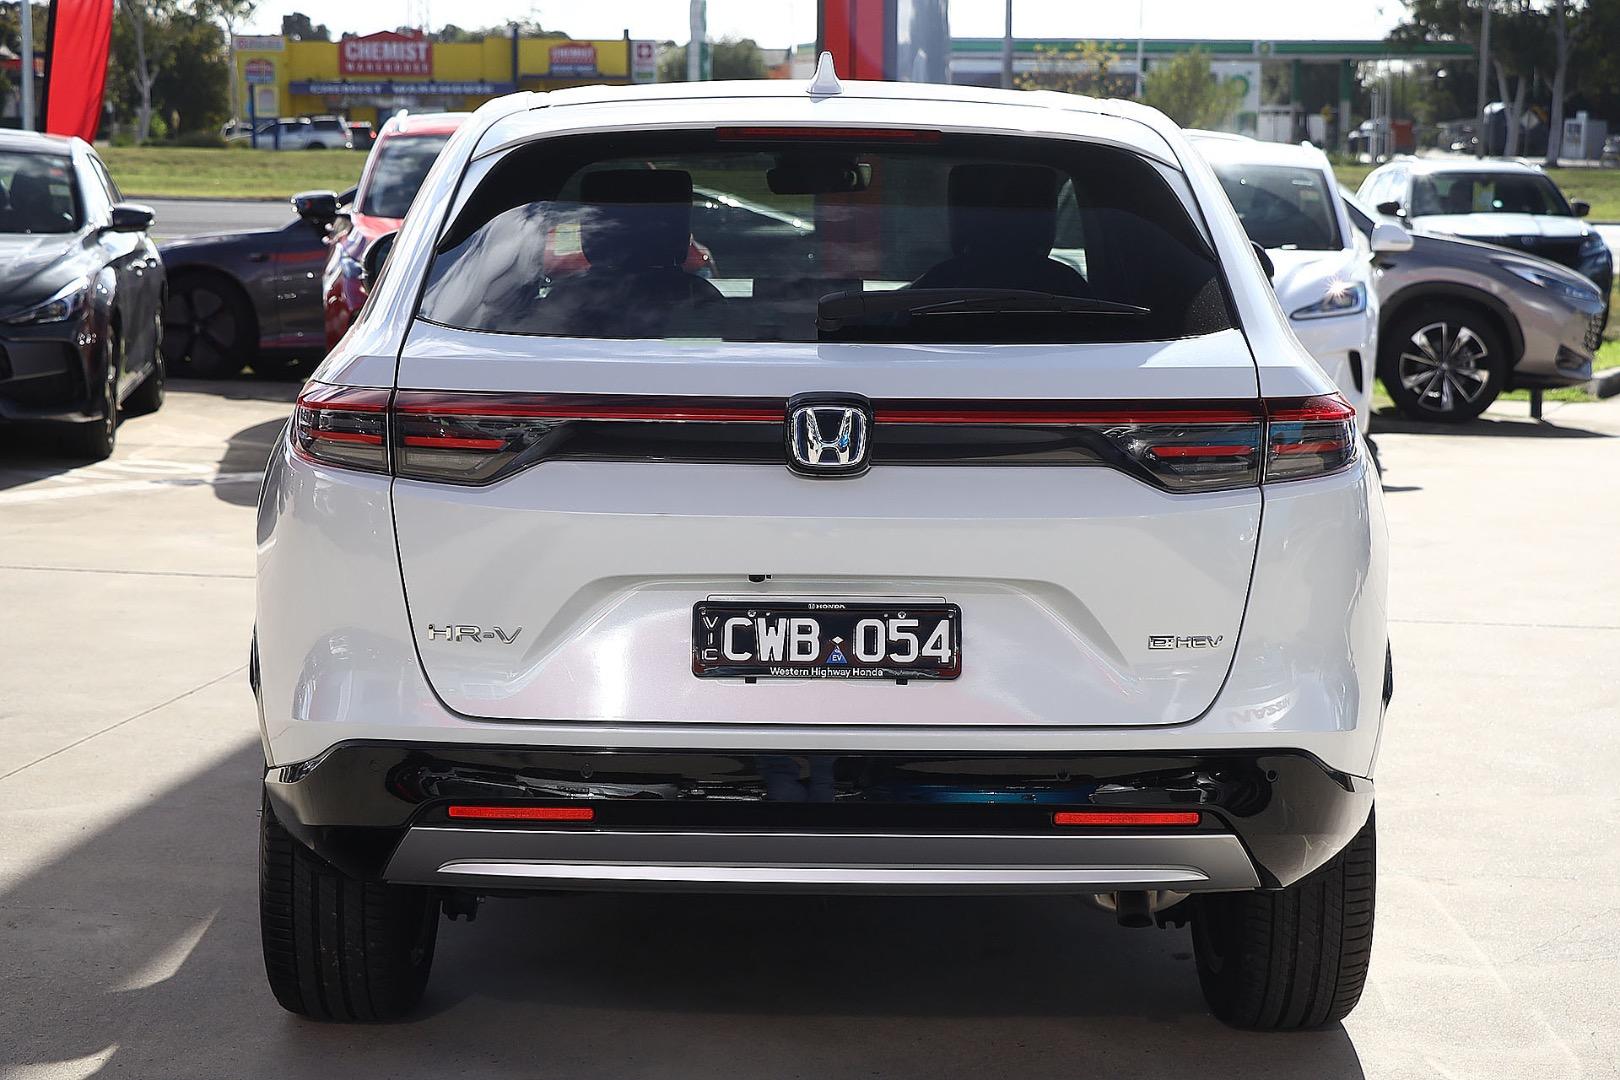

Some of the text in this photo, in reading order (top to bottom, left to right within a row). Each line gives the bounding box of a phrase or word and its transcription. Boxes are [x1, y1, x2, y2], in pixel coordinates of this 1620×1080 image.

[345, 41, 430, 61] CHEMIST
[309, 84, 382, 95] CHEMIST
[428, 624, 522, 644] HR-V
[702, 616, 719, 660] VIC
[723, 617, 952, 663] CWB 054
[770, 667, 884, 678] Western Highway Honda
